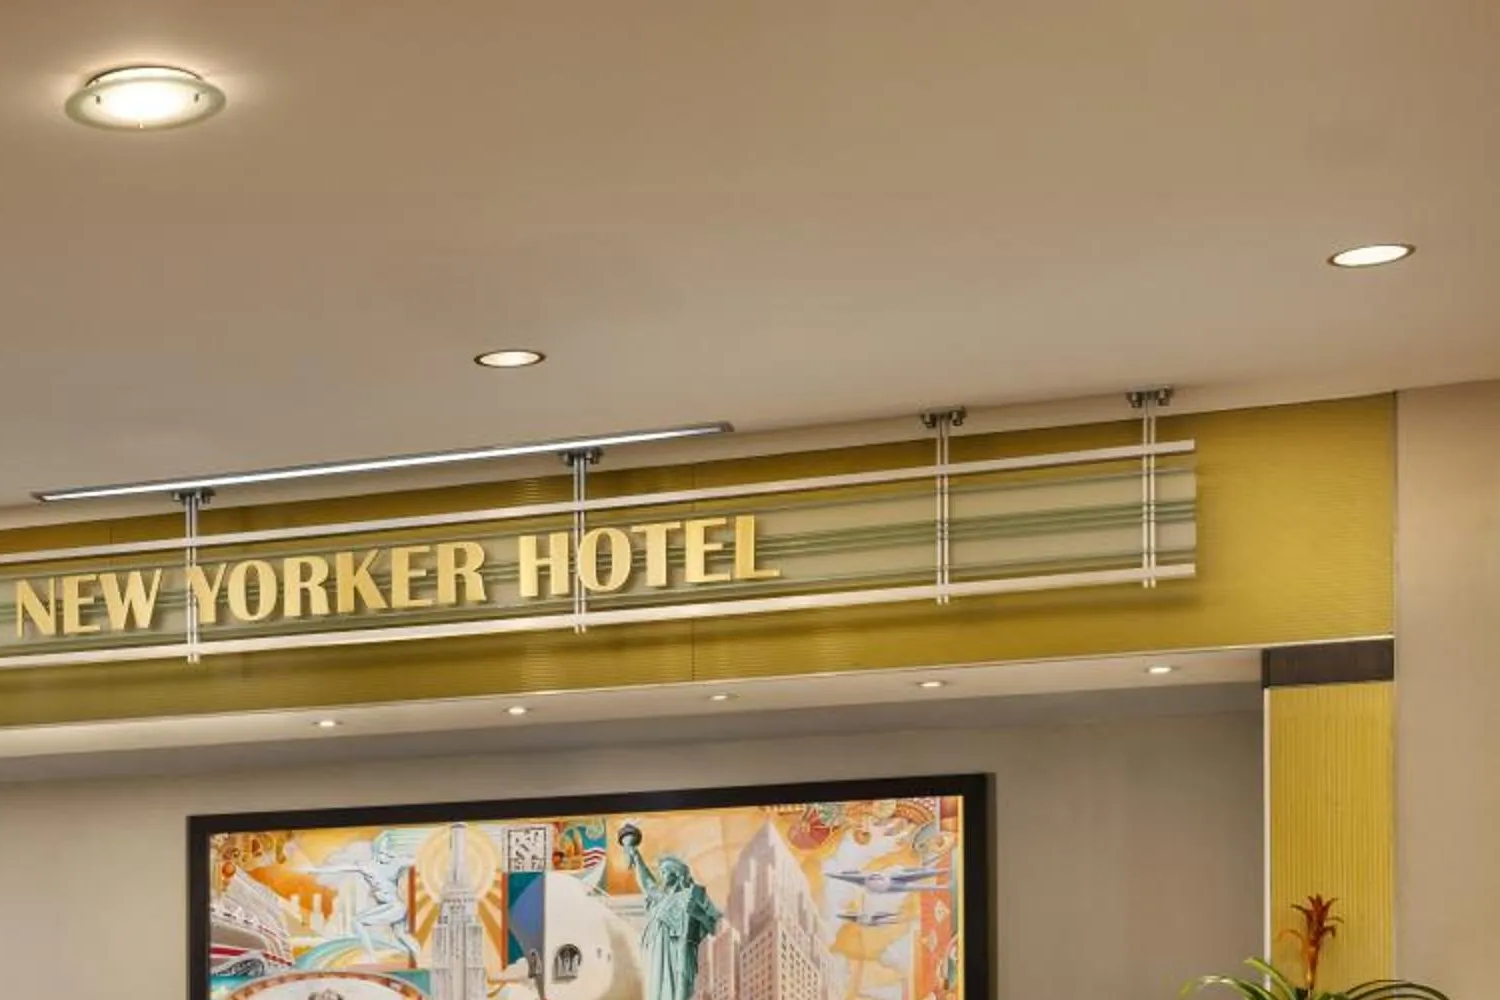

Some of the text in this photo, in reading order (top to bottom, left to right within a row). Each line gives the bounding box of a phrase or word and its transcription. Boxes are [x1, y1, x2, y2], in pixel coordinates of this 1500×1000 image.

[15, 515, 781, 638] NEW YORKER HOTEL
